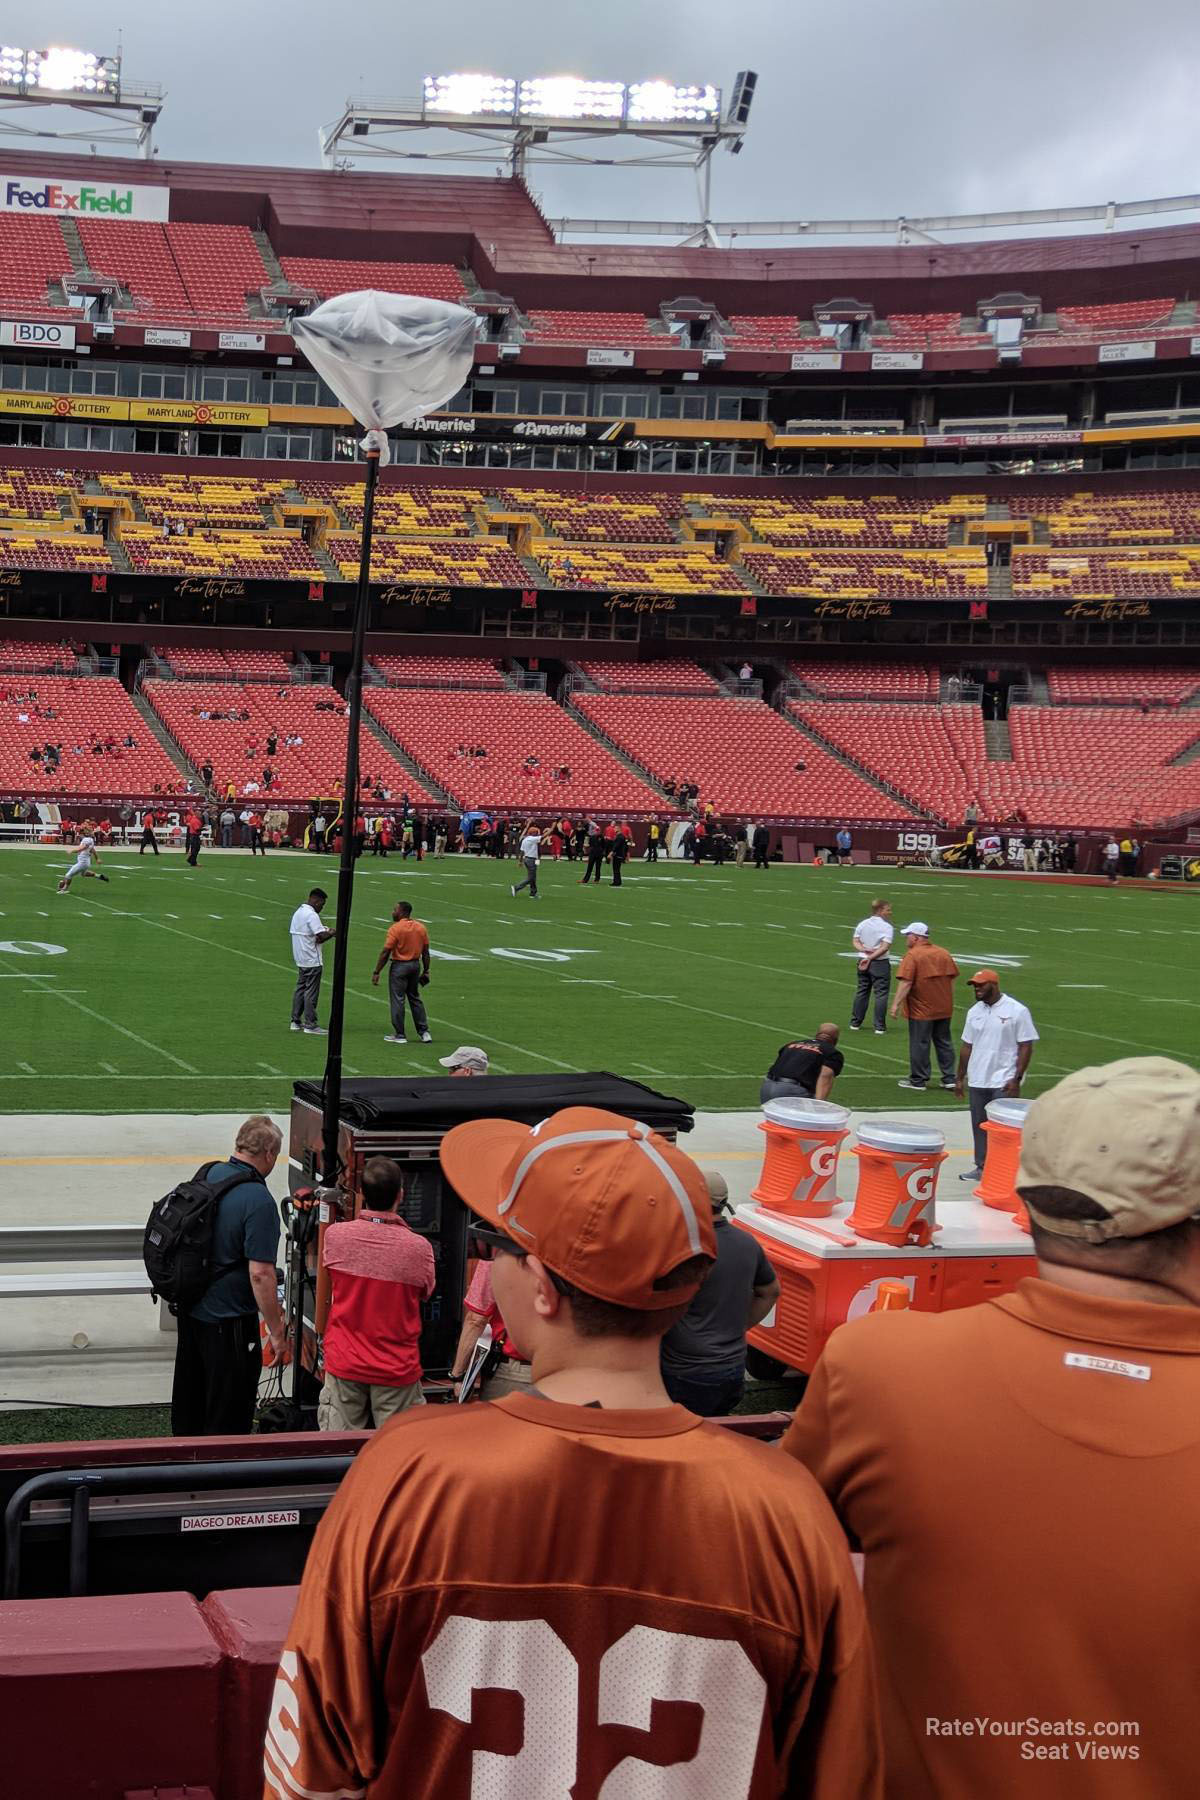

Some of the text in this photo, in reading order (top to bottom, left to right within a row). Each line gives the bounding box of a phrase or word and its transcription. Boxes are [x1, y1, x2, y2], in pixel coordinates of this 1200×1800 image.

[7, 182, 133, 214] FedExField
[19, 325, 61, 342] BDO
[6, 399, 52, 411] MARYLAND
[147, 407, 250, 421] MARYLAND LOTTERY
[415, 418, 476, 433] Ameritel
[525, 421, 586, 437] Ameritel
[91, 574, 107, 592] M
[308, 582, 324, 600] M
[521, 590, 537, 608] M
[740, 597, 757, 615] M
[969, 601, 988, 619] M
[897, 833, 938, 850] 1991
[810, 1145, 836, 1176] G
[907, 1168, 934, 1201] G
[183, 1512, 298, 1529] DIAGEO DREAM SEATS
[422, 1616, 768, 1800] 32
